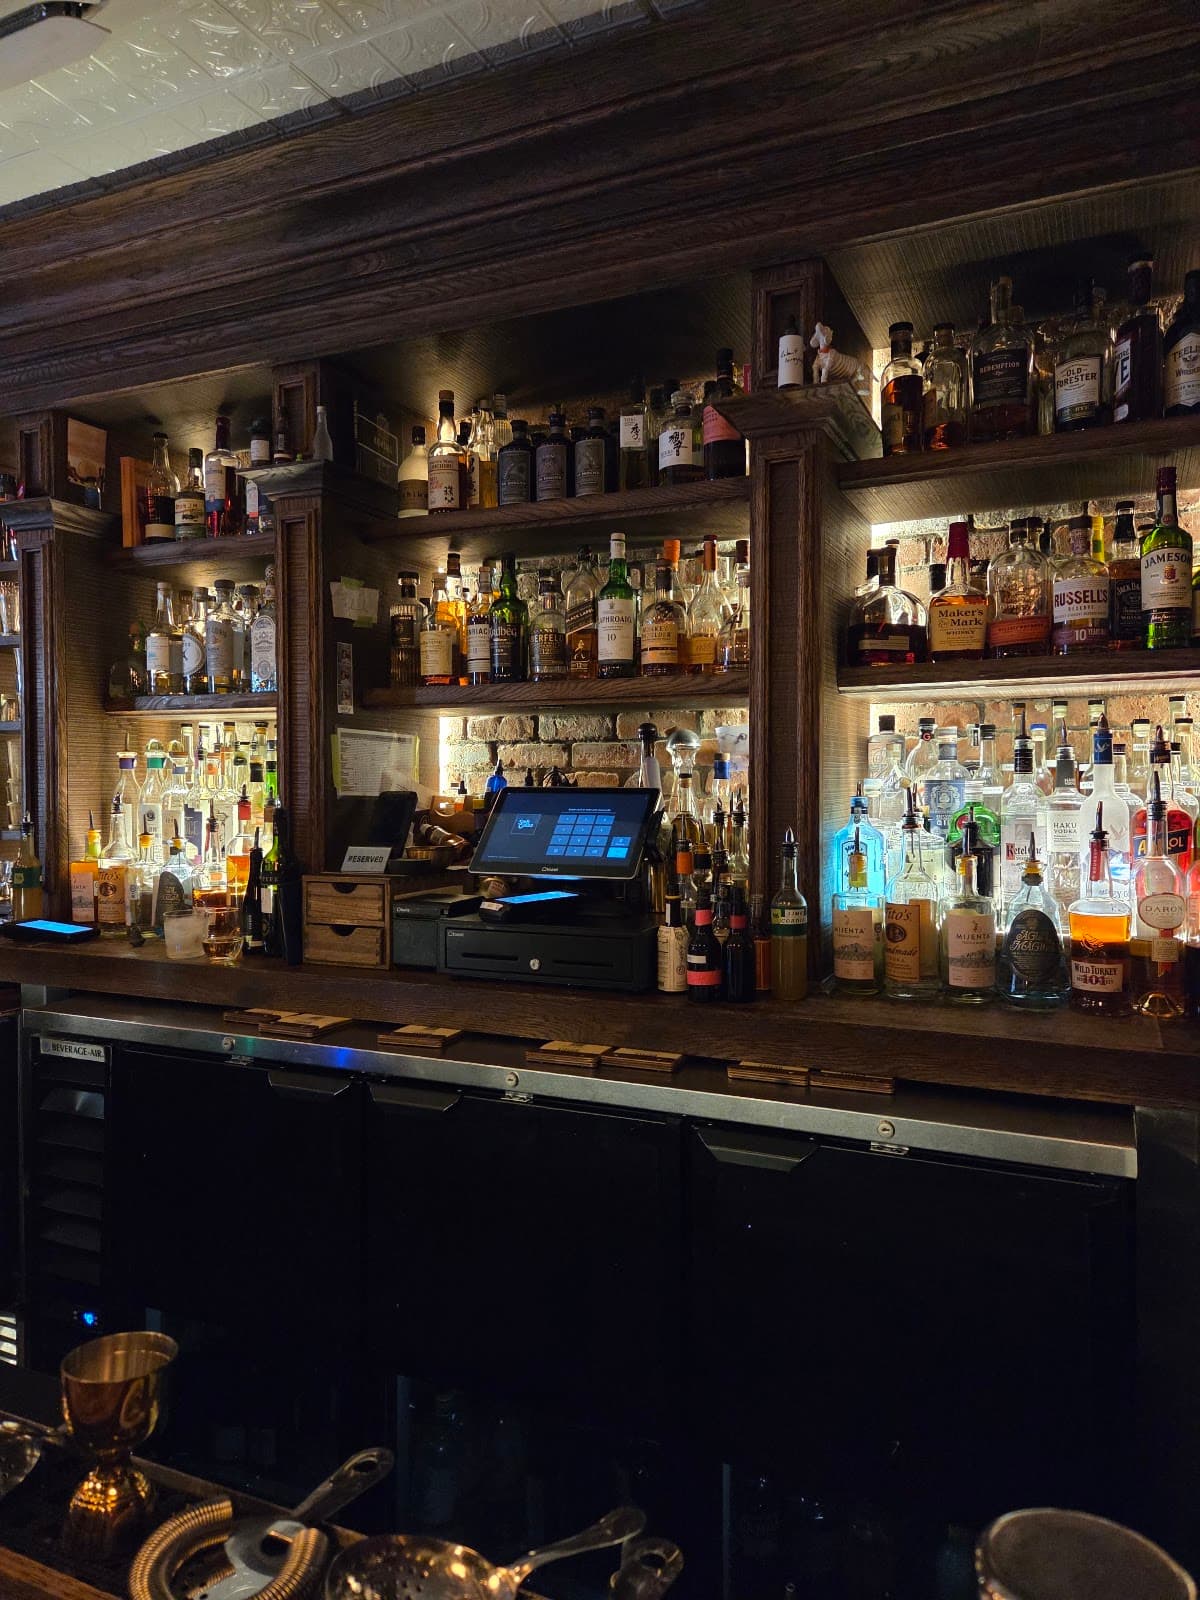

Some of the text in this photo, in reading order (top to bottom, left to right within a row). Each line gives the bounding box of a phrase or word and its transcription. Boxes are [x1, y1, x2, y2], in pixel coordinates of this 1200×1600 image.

[1172, 344, 1200, 362] TEELI
[1066, 367, 1082, 378] OLD
[1056, 372, 1097, 390] FORESTER
[1054, 588, 1108, 608] RUSSELL'S
[938, 608, 984, 618] Maker's
[950, 618, 984, 626] Mark
[607, 633, 616, 641] 10
[1074, 629, 1087, 641] 10
[1138, 836, 1184, 855] AOL
[347, 855, 384, 863] RESERVED
[956, 932, 990, 940] MIJENTA
[1074, 962, 1118, 976] WILD TURKEY
[1083, 974, 1106, 986] 101
[51, 1043, 105, 1058] BEVERAGE-AIR
